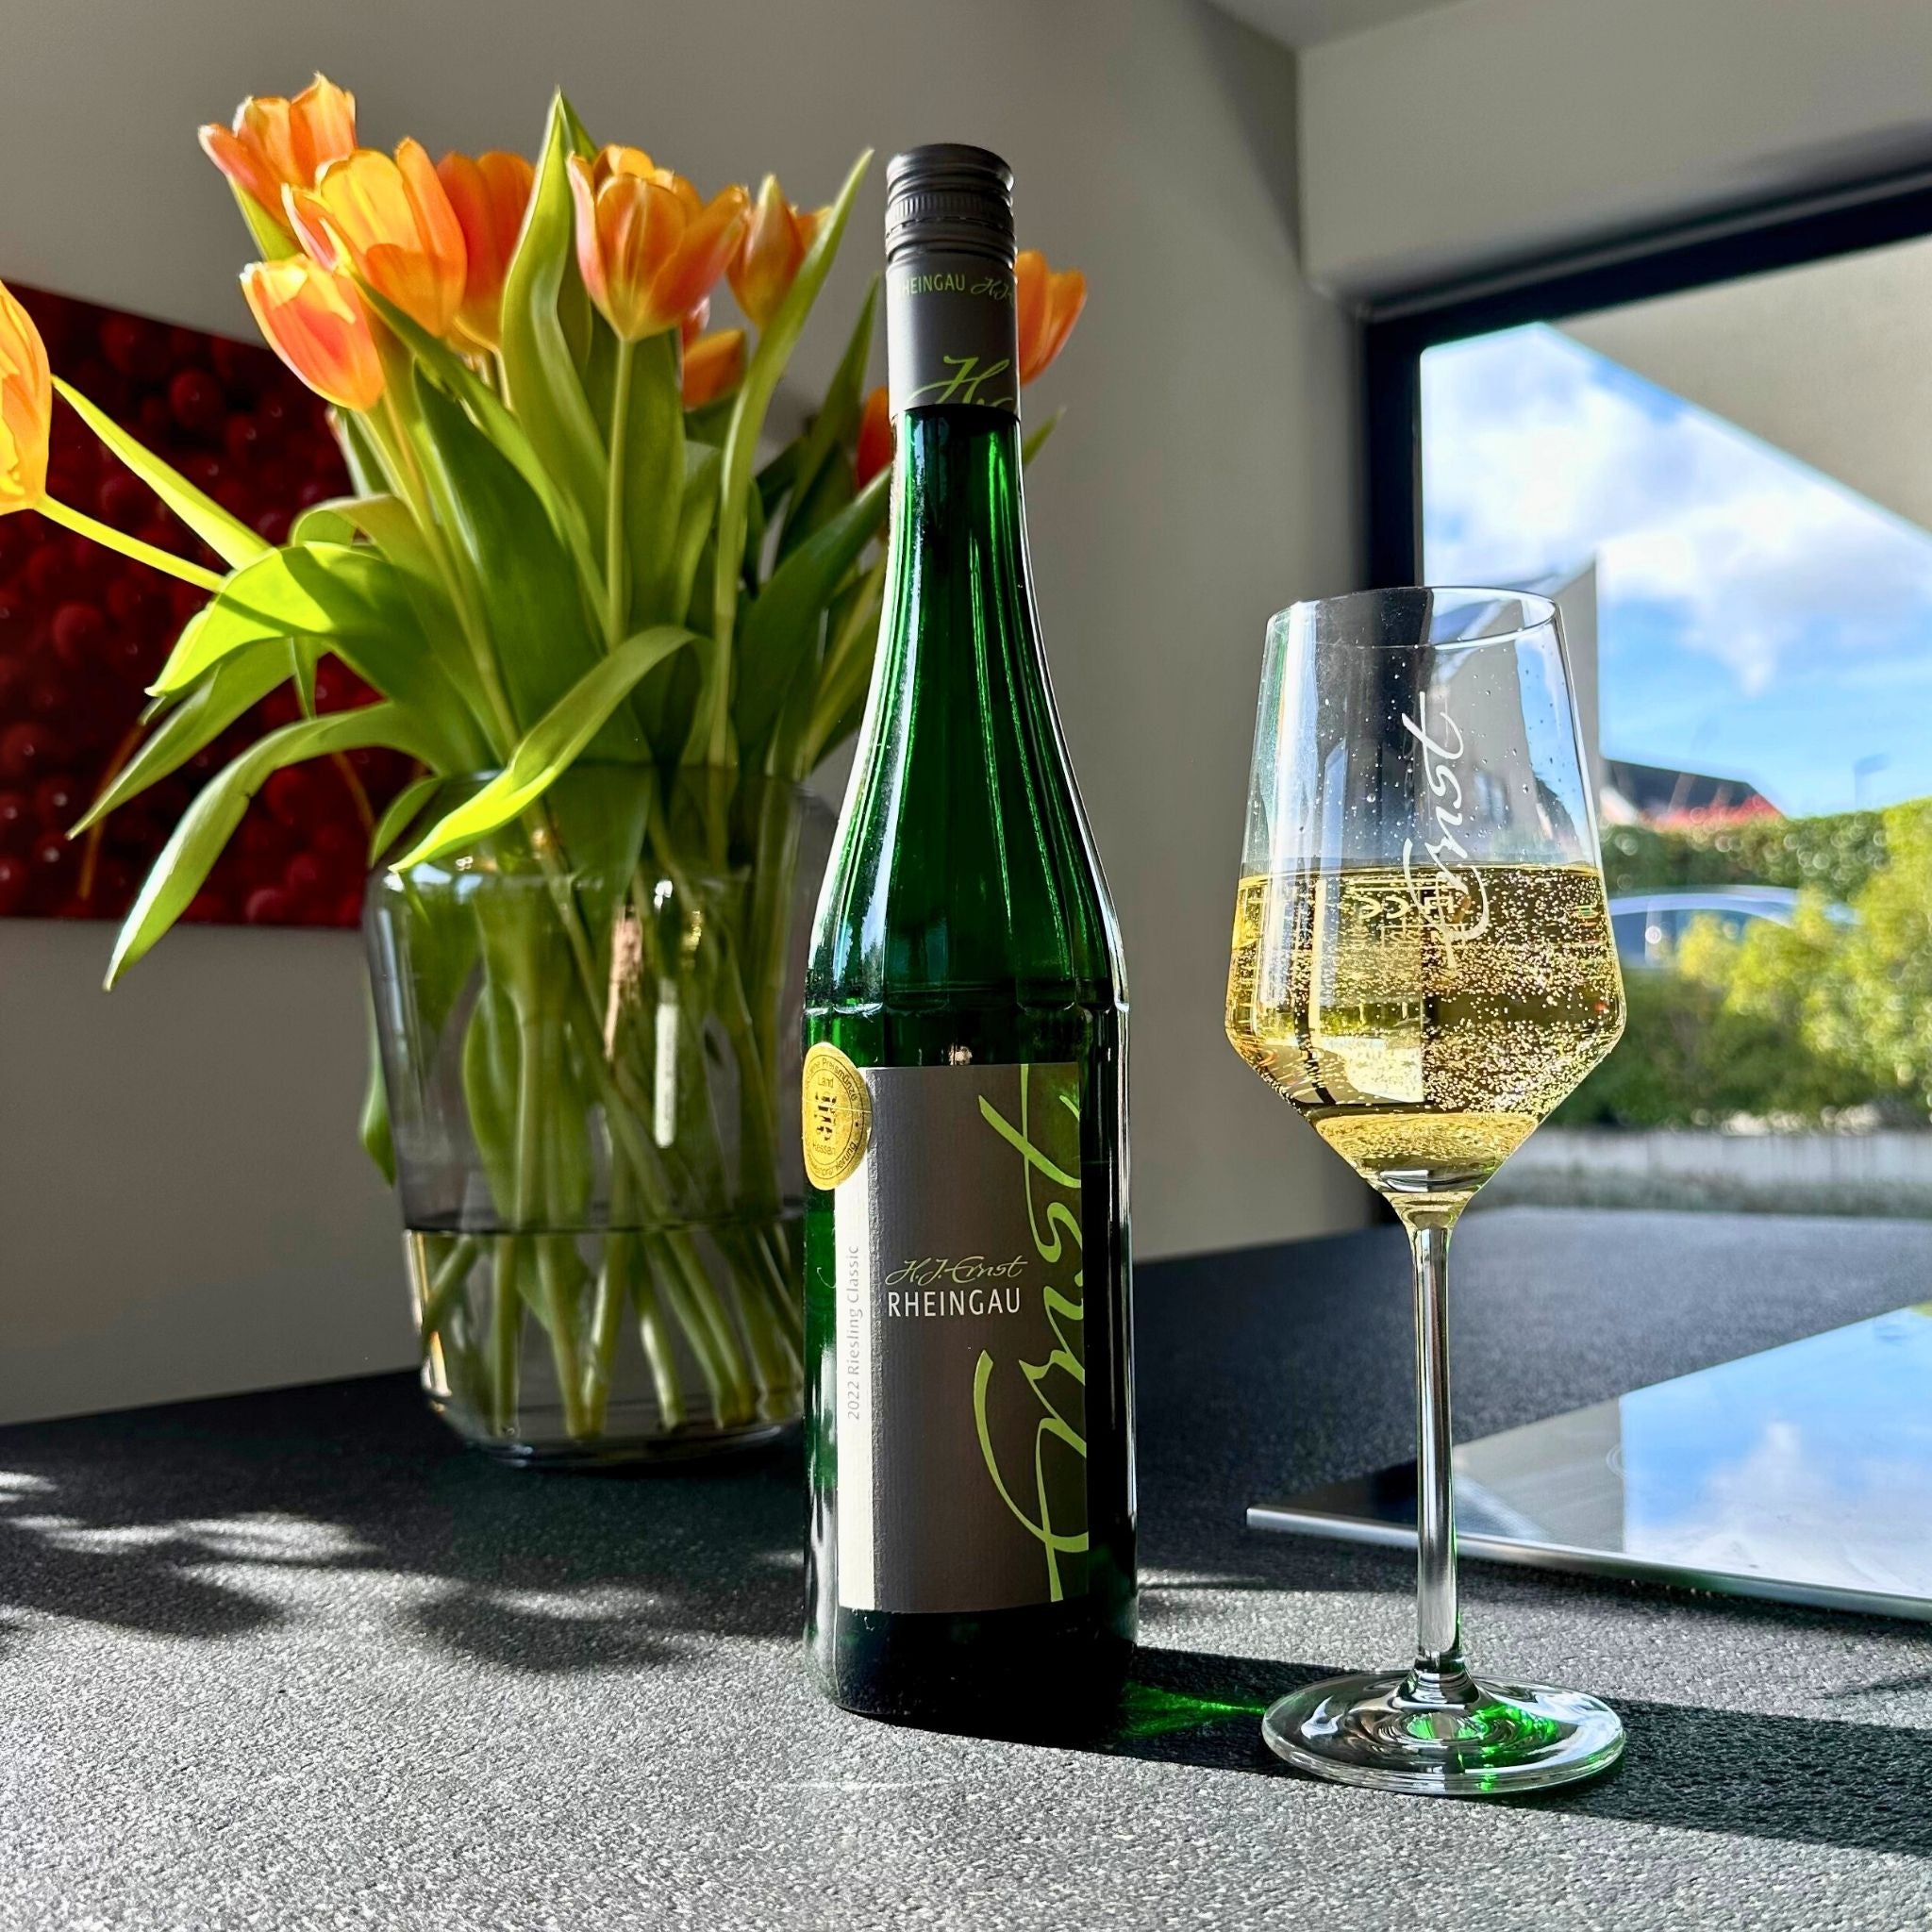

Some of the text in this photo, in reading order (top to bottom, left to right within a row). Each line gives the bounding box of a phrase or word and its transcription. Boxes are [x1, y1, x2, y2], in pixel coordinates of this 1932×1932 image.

[899, 274, 966, 295] HEINGAU
[1401, 691, 1490, 975] Ernst
[944, 1256, 1028, 1284] Ernst
[888, 1288, 1021, 1317] RHEINGAU
[846, 1245, 863, 1421] 2022 Riesling Classic
